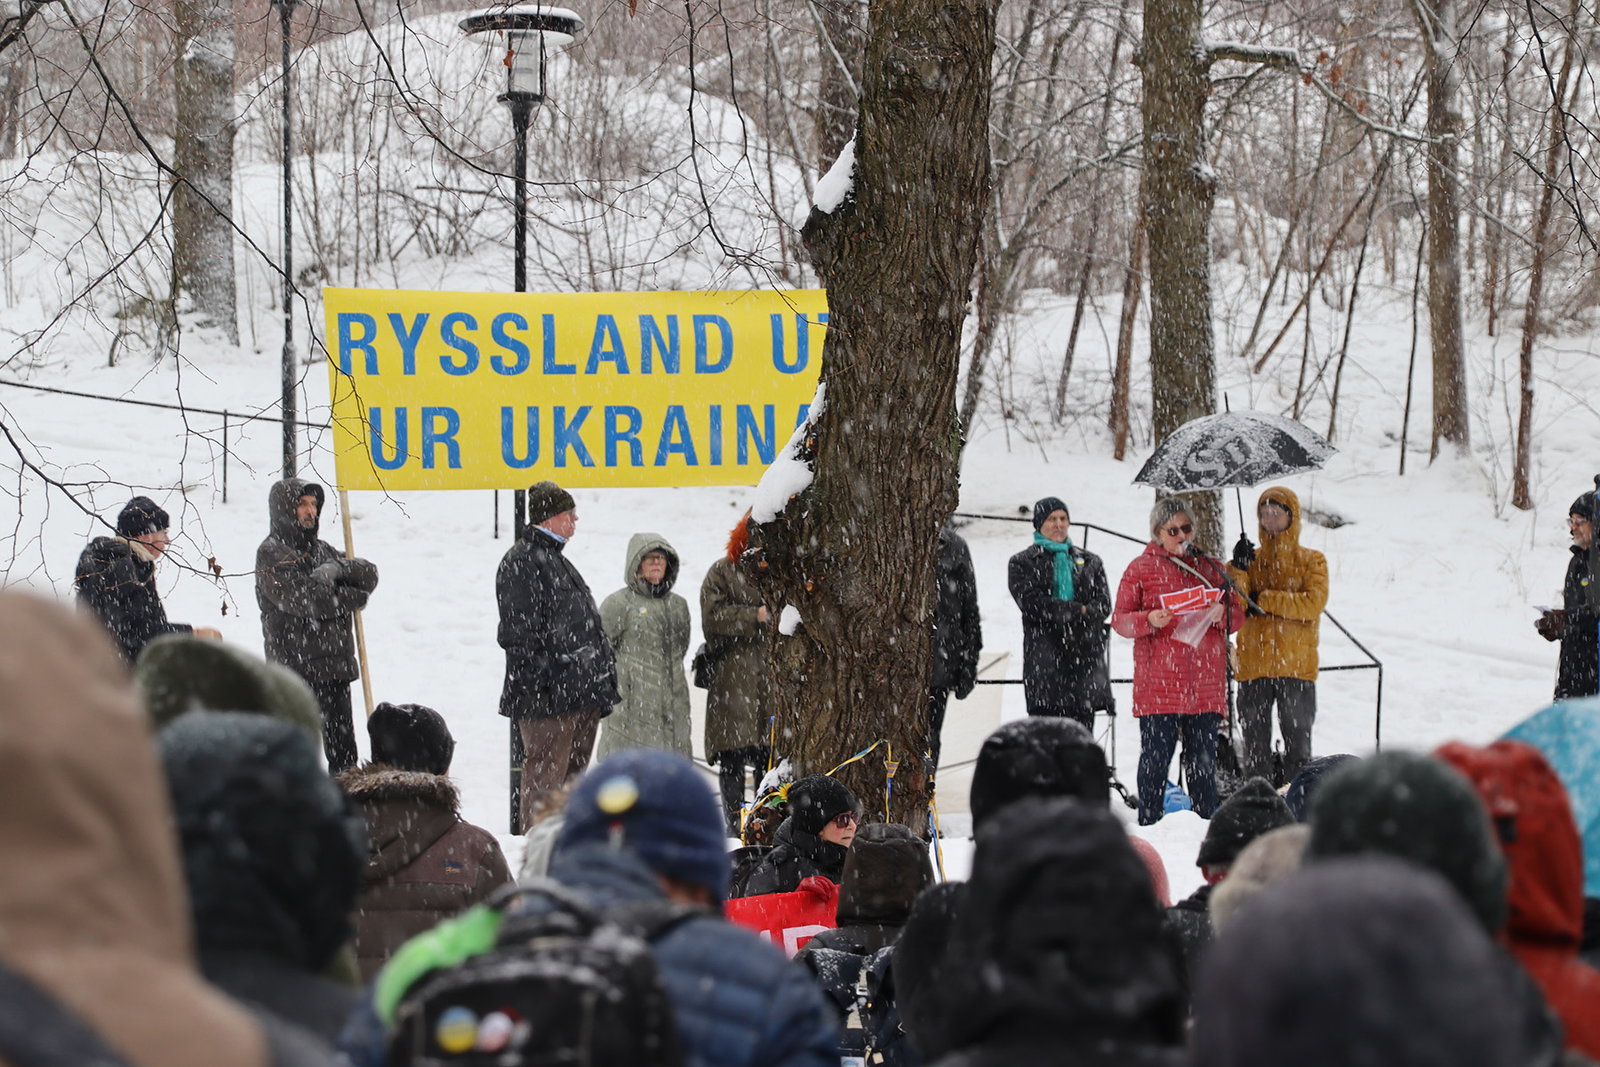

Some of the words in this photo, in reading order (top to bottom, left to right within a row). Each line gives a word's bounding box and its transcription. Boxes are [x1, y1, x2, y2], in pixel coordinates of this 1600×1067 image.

[337, 312, 734, 376] RYSSLAND
[369, 406, 462, 470] UR
[501, 404, 811, 468] UKRAIN
